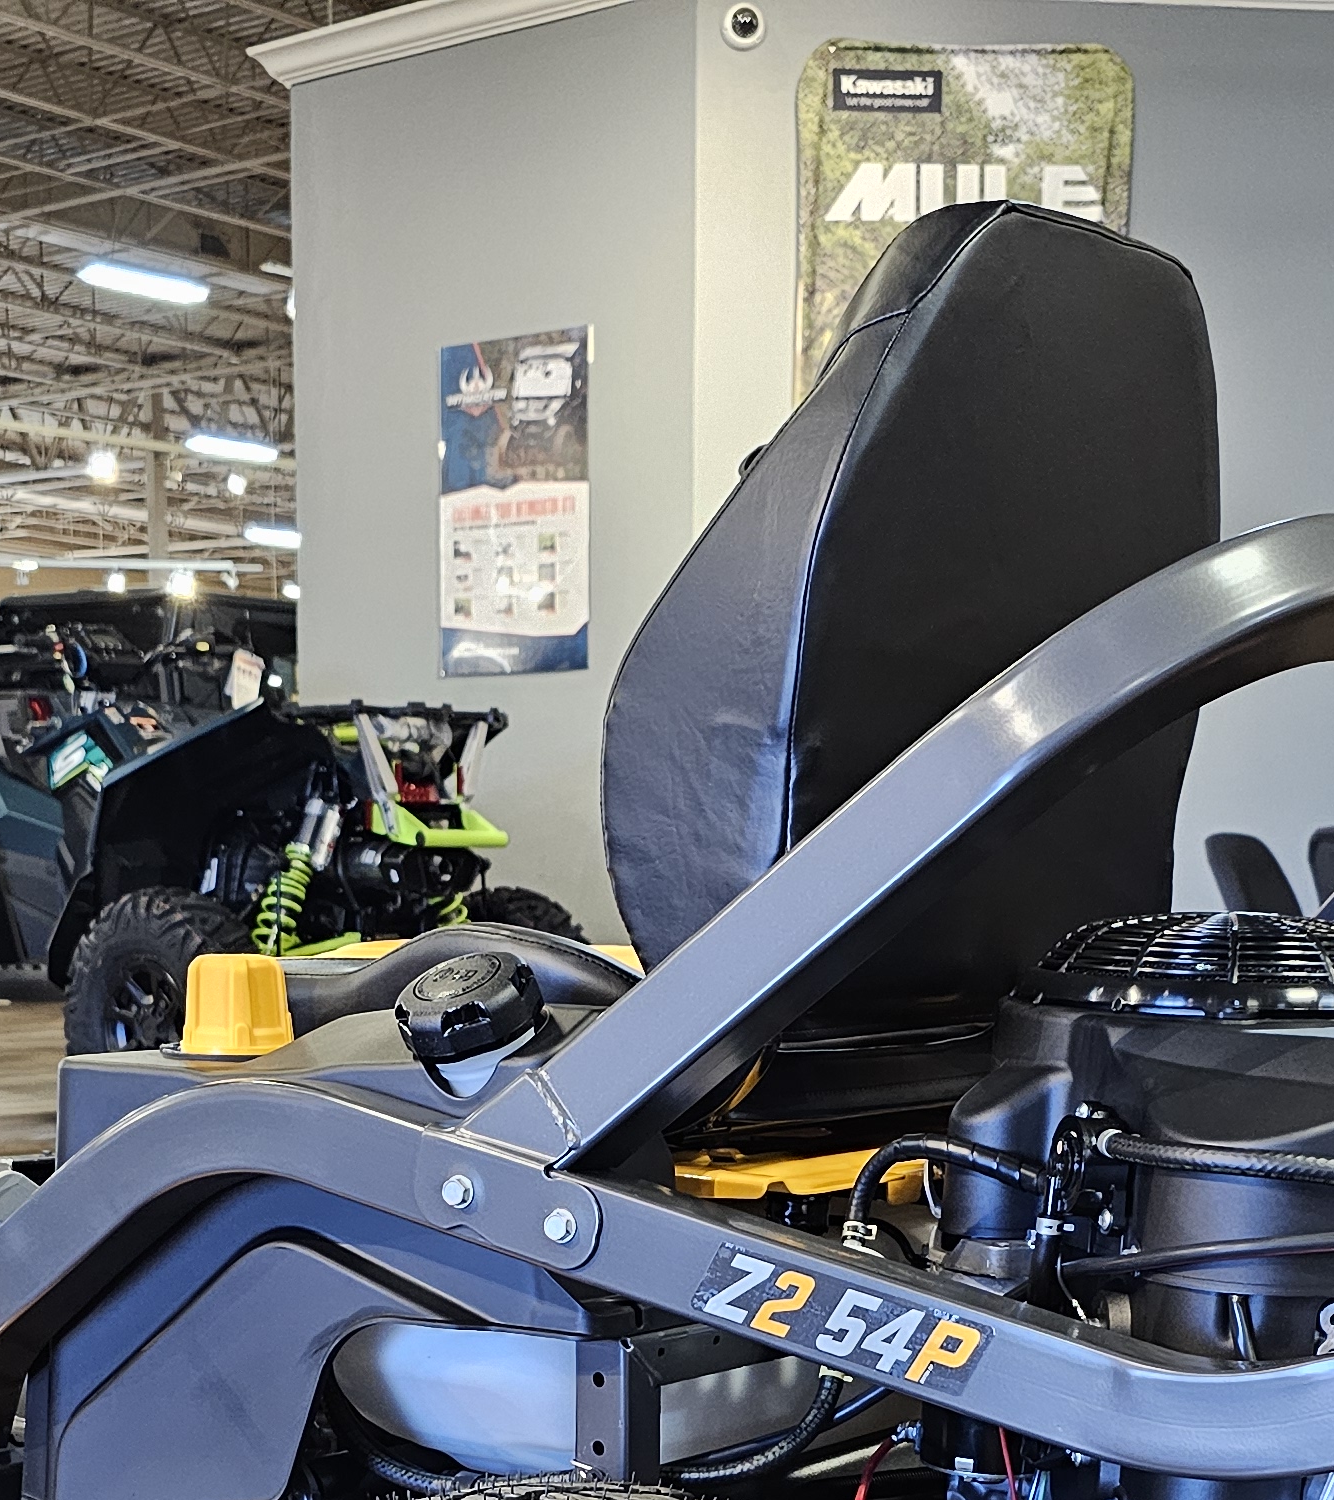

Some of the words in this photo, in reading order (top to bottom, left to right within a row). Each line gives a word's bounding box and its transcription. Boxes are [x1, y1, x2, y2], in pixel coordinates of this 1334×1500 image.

[840, 74, 934, 96] Kawasaki
[825, 162, 1104, 222] MULE
[702, 1254, 816, 1339] Z2
[815, 1288, 983, 1384] 54P
